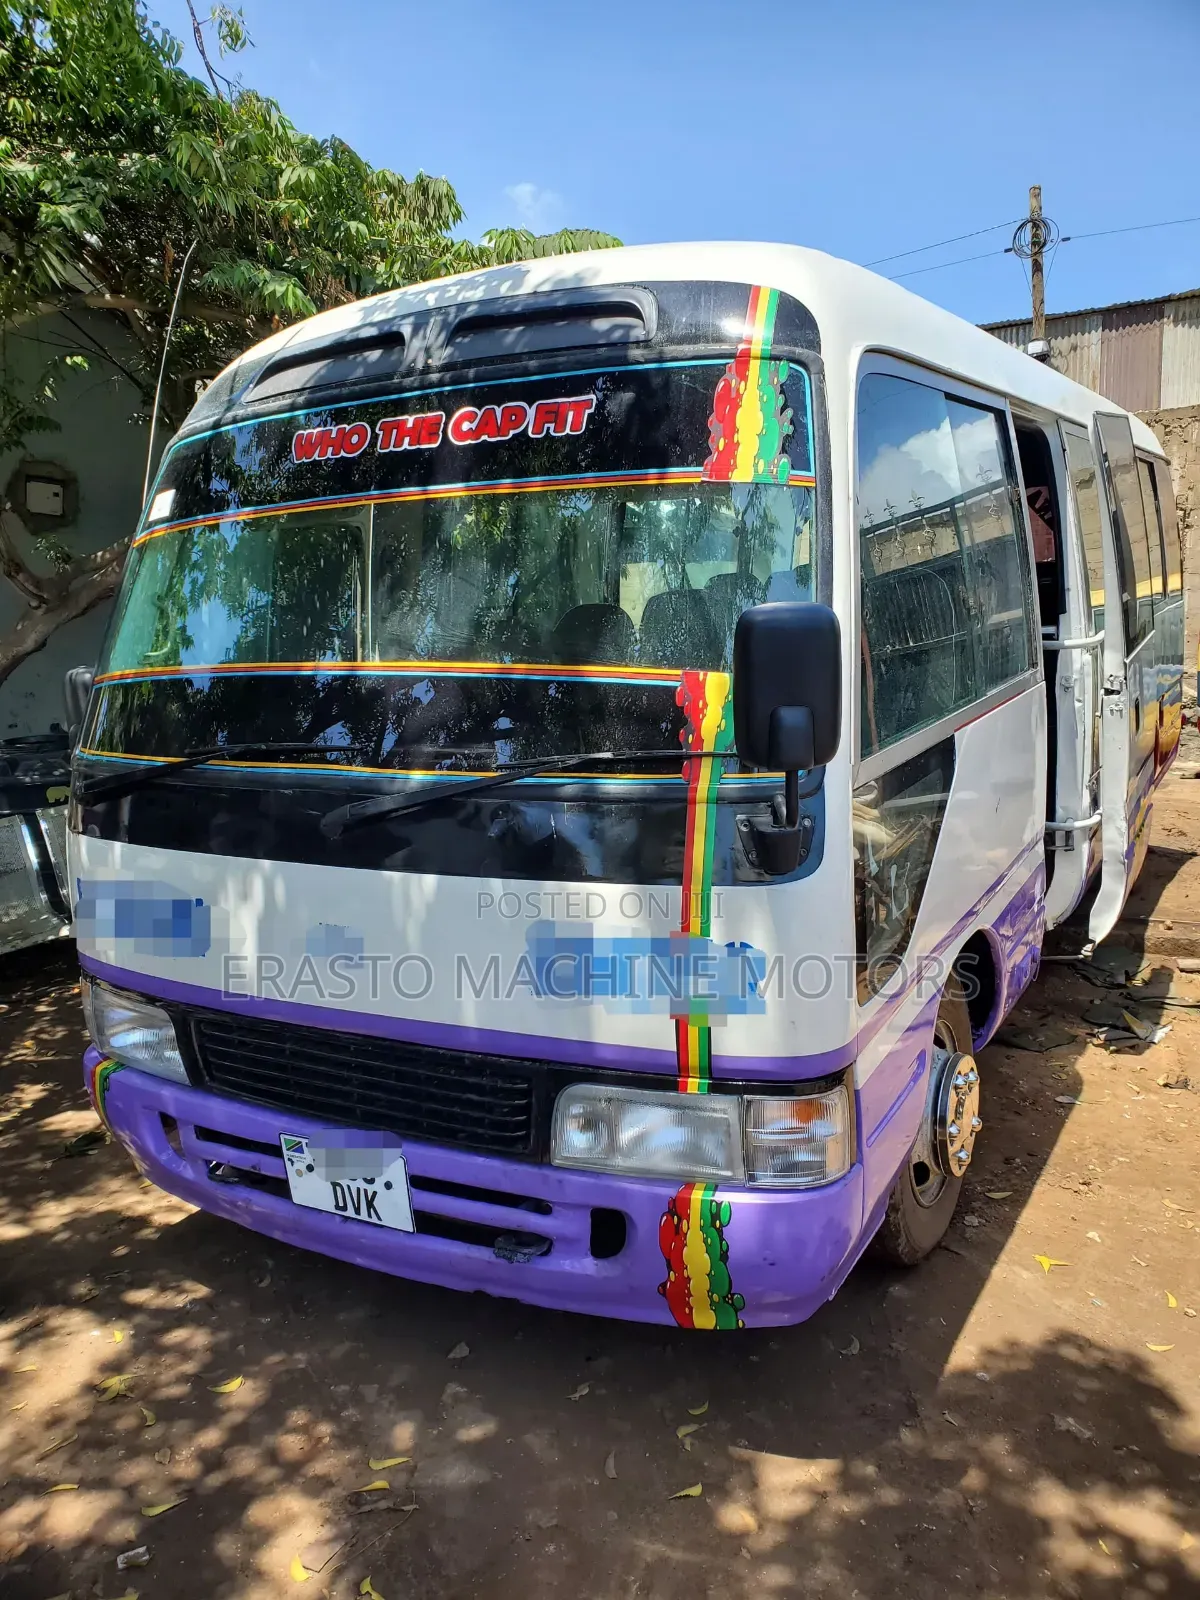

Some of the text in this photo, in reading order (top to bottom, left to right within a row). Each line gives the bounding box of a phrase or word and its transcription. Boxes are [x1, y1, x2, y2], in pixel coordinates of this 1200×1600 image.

[292, 394, 597, 463] WHO THE CAP FIT
[330, 1181, 383, 1222] DVK
